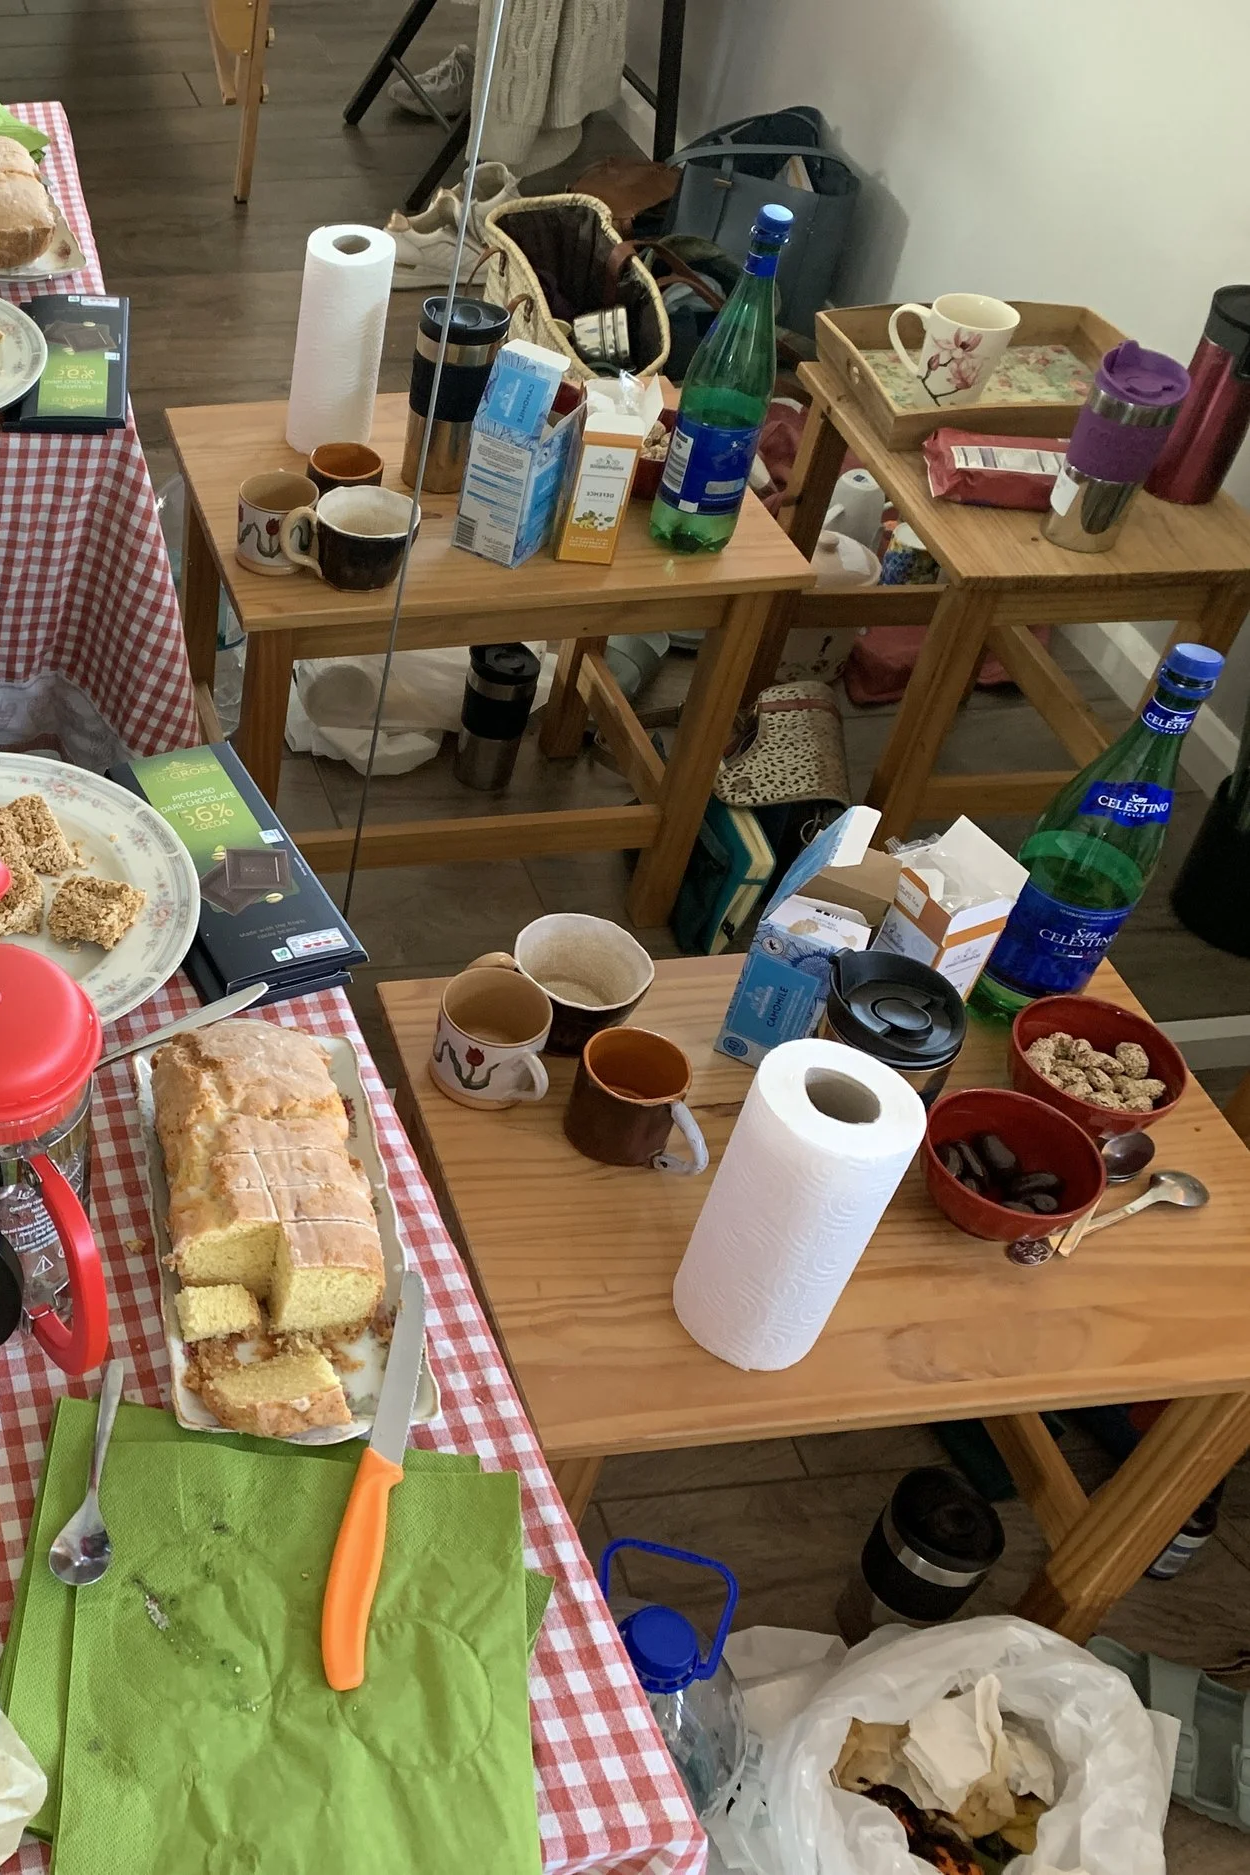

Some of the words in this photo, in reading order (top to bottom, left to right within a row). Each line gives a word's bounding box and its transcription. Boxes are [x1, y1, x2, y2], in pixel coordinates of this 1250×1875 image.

[171, 786, 216, 801] PISTACHIO
[1129, 794, 1149, 803] San
[159, 802, 185, 814] DARK
[186, 791, 237, 808] CHOCOLATE
[1097, 795, 1170, 814] CELESTINO
[193, 818, 231, 832] COCOA
[1075, 928, 1102, 939] San
[766, 985, 789, 1028] CAMOMILE
